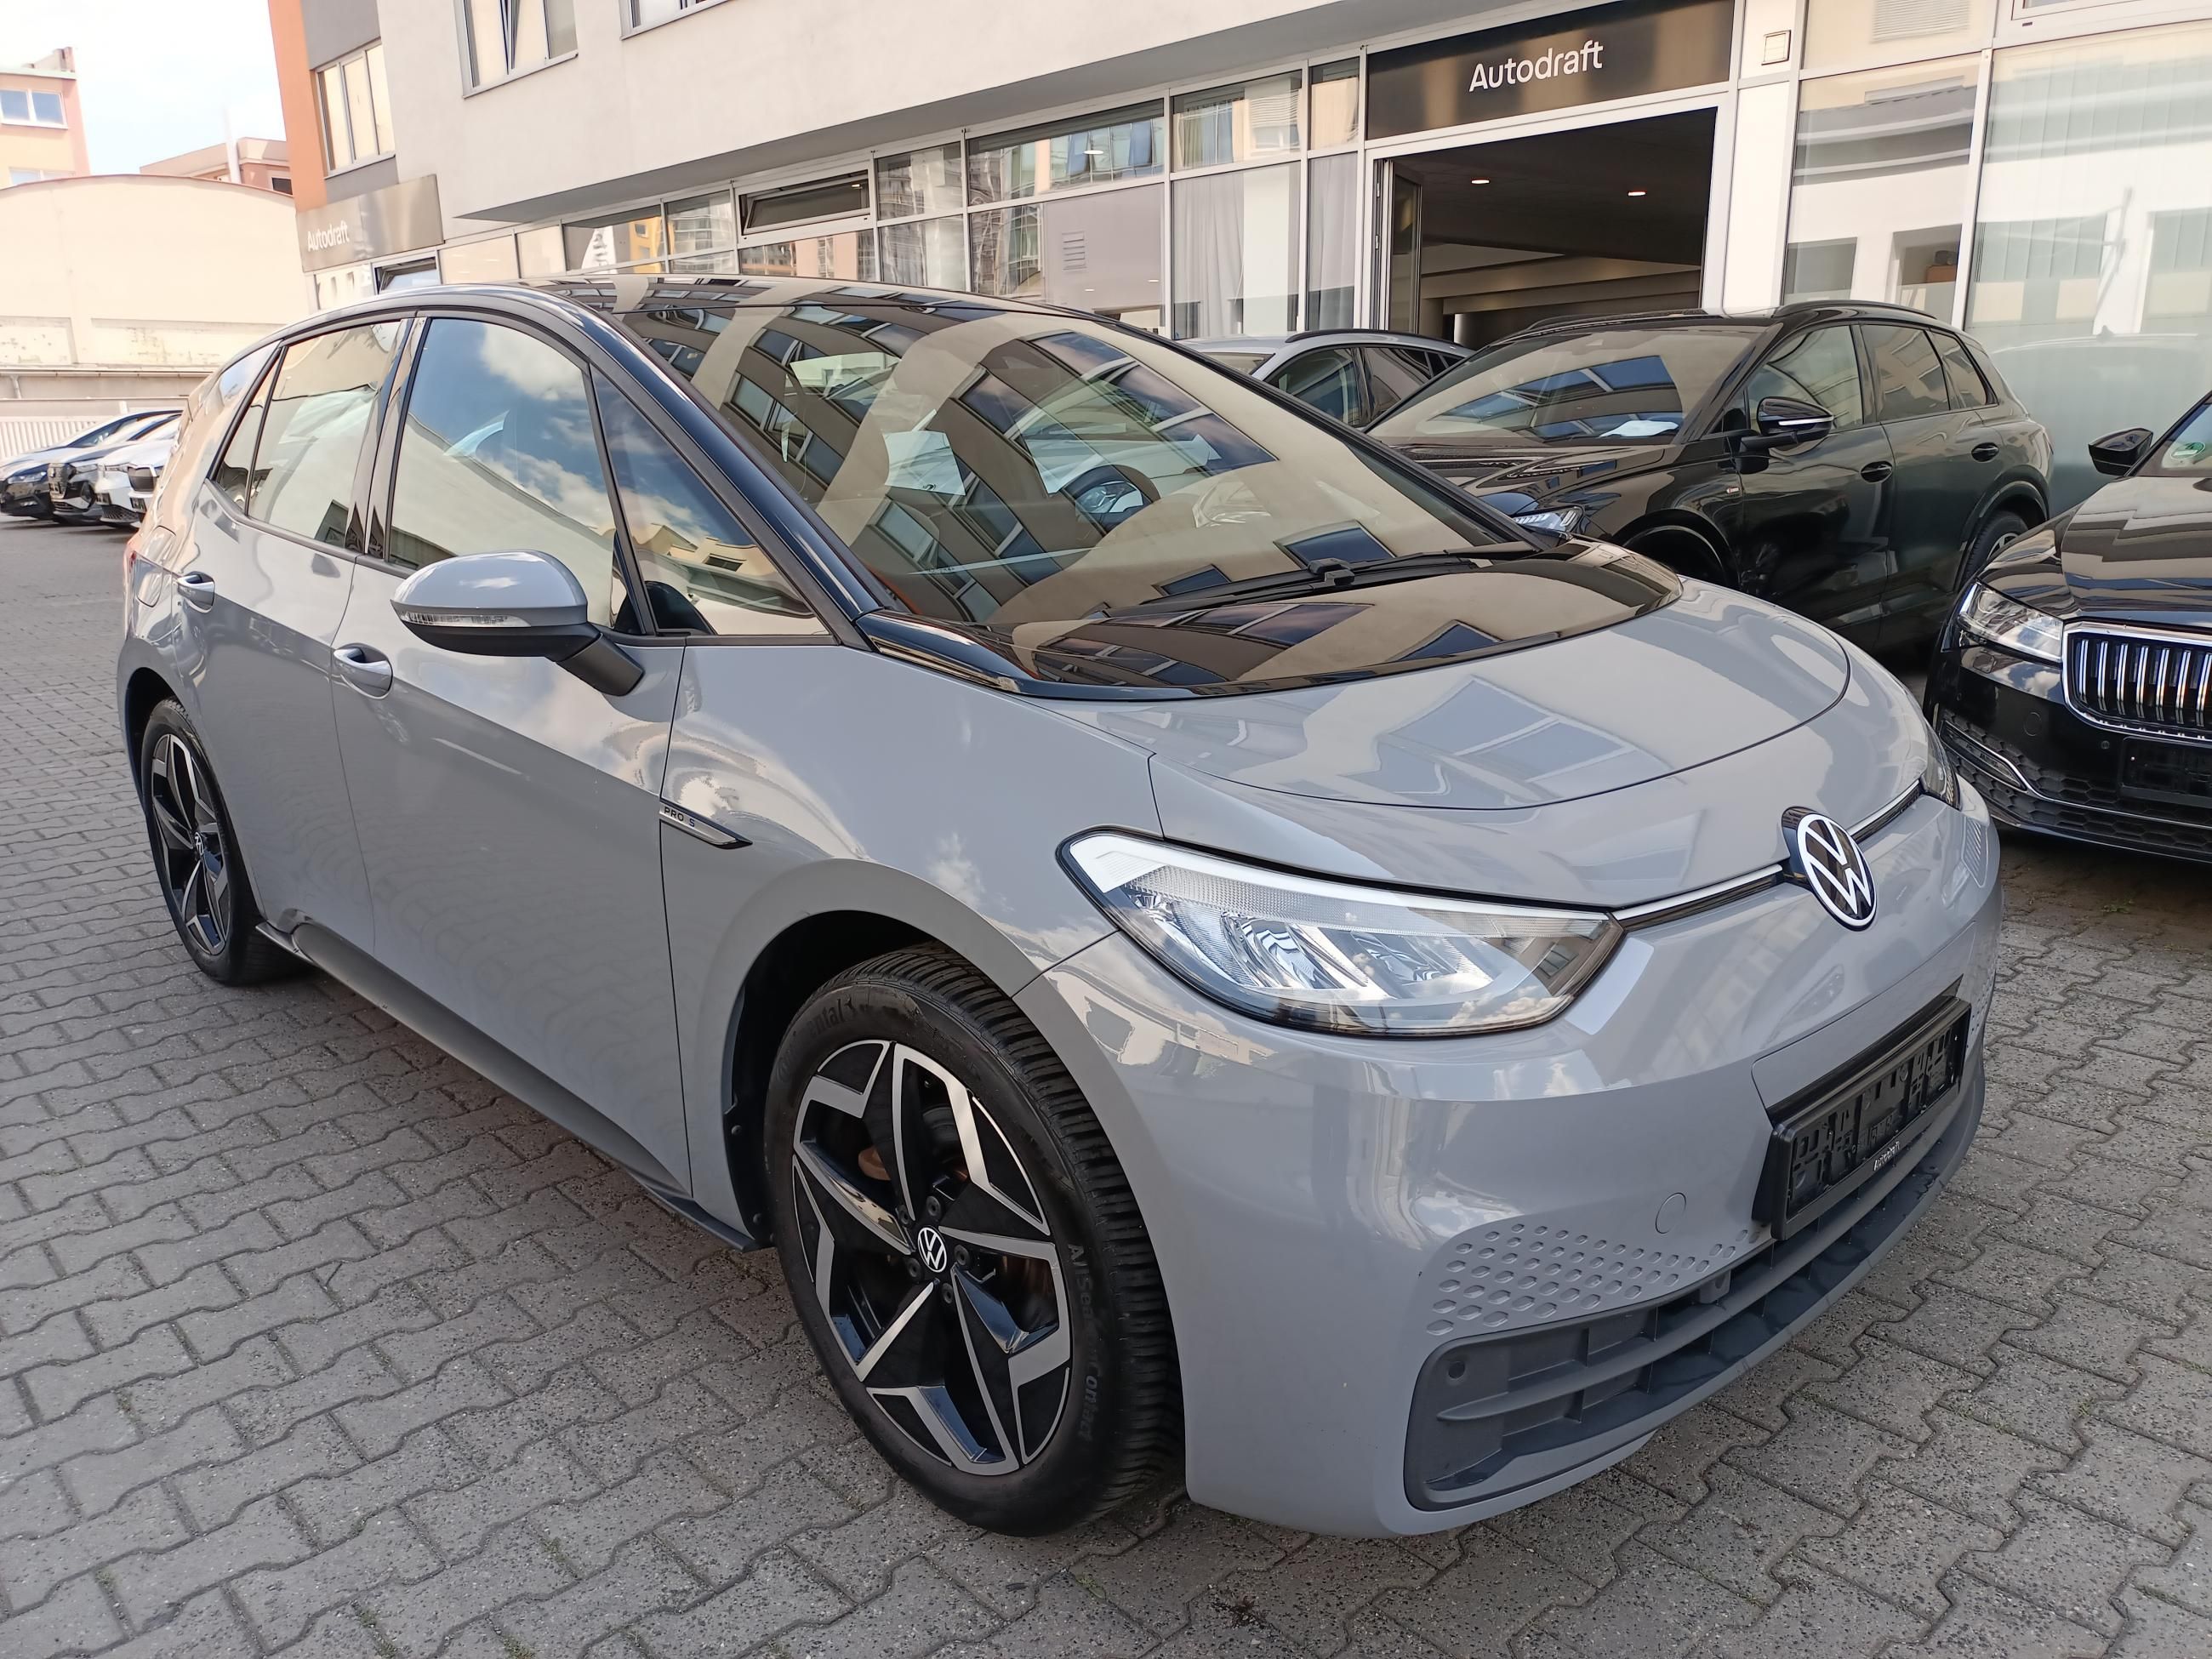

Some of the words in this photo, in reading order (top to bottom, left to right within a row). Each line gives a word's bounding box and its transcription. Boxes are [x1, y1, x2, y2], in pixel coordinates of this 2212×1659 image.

[1468, 39, 1604, 93] Autodraft
[307, 219, 350, 252] Autodraft
[664, 807, 684, 822] PRO
[689, 818, 695, 828] S
